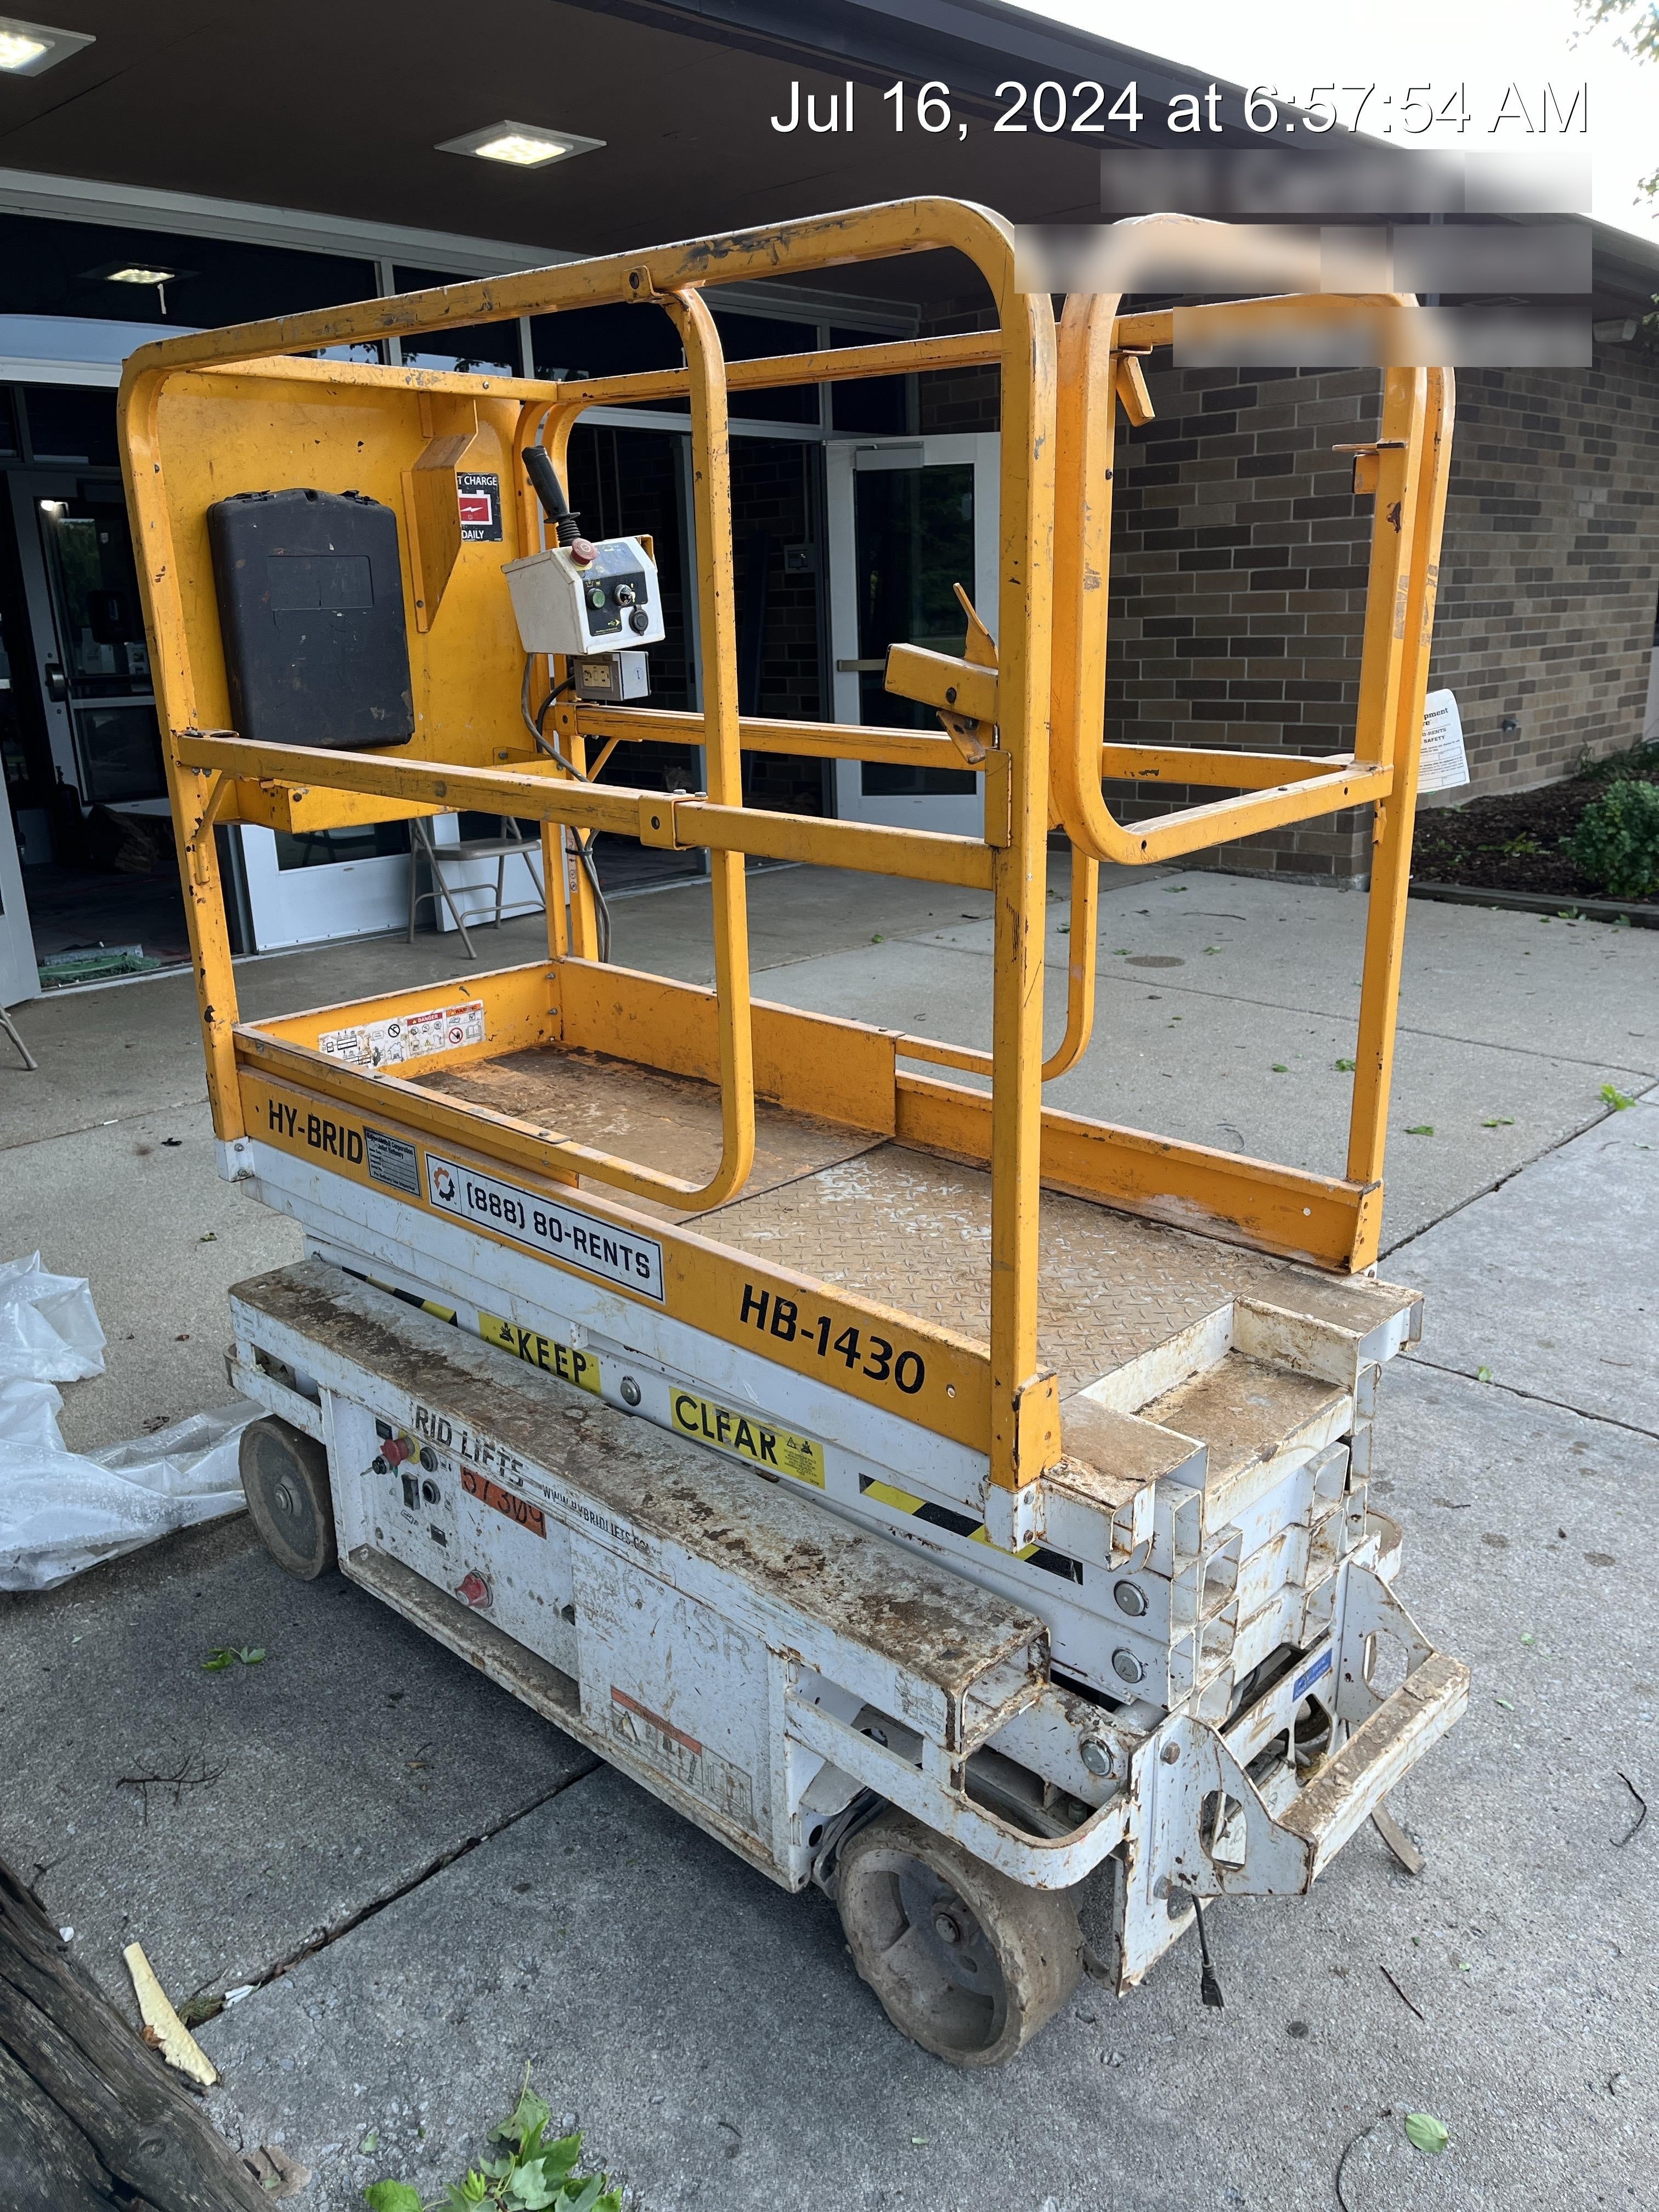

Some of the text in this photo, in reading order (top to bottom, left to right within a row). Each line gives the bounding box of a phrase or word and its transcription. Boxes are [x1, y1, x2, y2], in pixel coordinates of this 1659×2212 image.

[464, 476, 498, 486] CHARGE
[461, 530, 484, 539] DAILY
[1424, 735, 1445, 743] SAFETY
[417, 1013, 438, 1023] DANGER
[268, 1099, 363, 1164] HY-BRID
[388, 1148, 404, 1159] Refinery
[391, 1142, 414, 1155] Corporation
[467, 1181, 651, 1279] (888) 80-RENTS
[740, 1283, 926, 1394] HB-1430
[517, 1329, 587, 1384] KEEP
